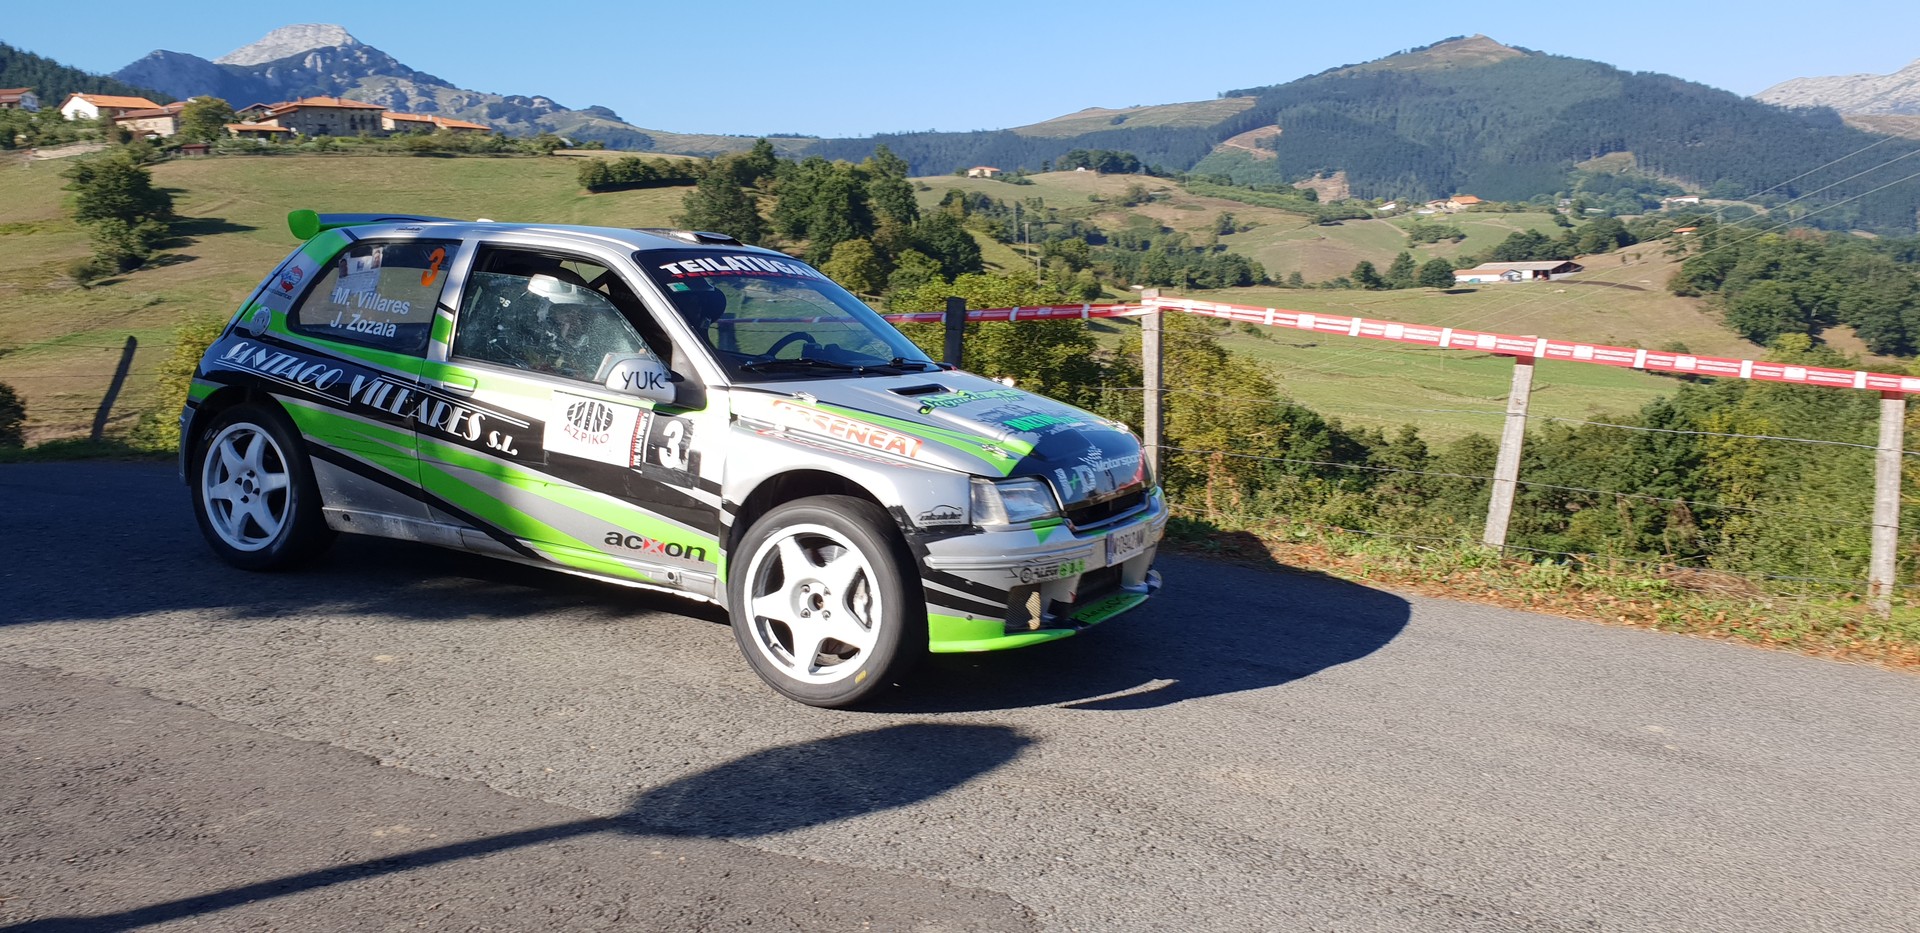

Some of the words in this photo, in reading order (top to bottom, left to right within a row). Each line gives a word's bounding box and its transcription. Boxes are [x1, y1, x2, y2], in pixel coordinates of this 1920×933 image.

[420, 247, 446, 287] 3
[332, 286, 351, 306] M.
[357, 290, 411, 315] Villares
[329, 310, 342, 328] J.
[347, 313, 397, 338] Zozaia
[621, 371, 665, 390] YUK
[220, 341, 344, 390] SANTIAGO
[350, 373, 486, 442] VILLARES
[486, 429, 518, 456] S.L.
[563, 423, 609, 445] AZPIKO
[658, 419, 684, 469] 3
[603, 531, 706, 562] acxon
